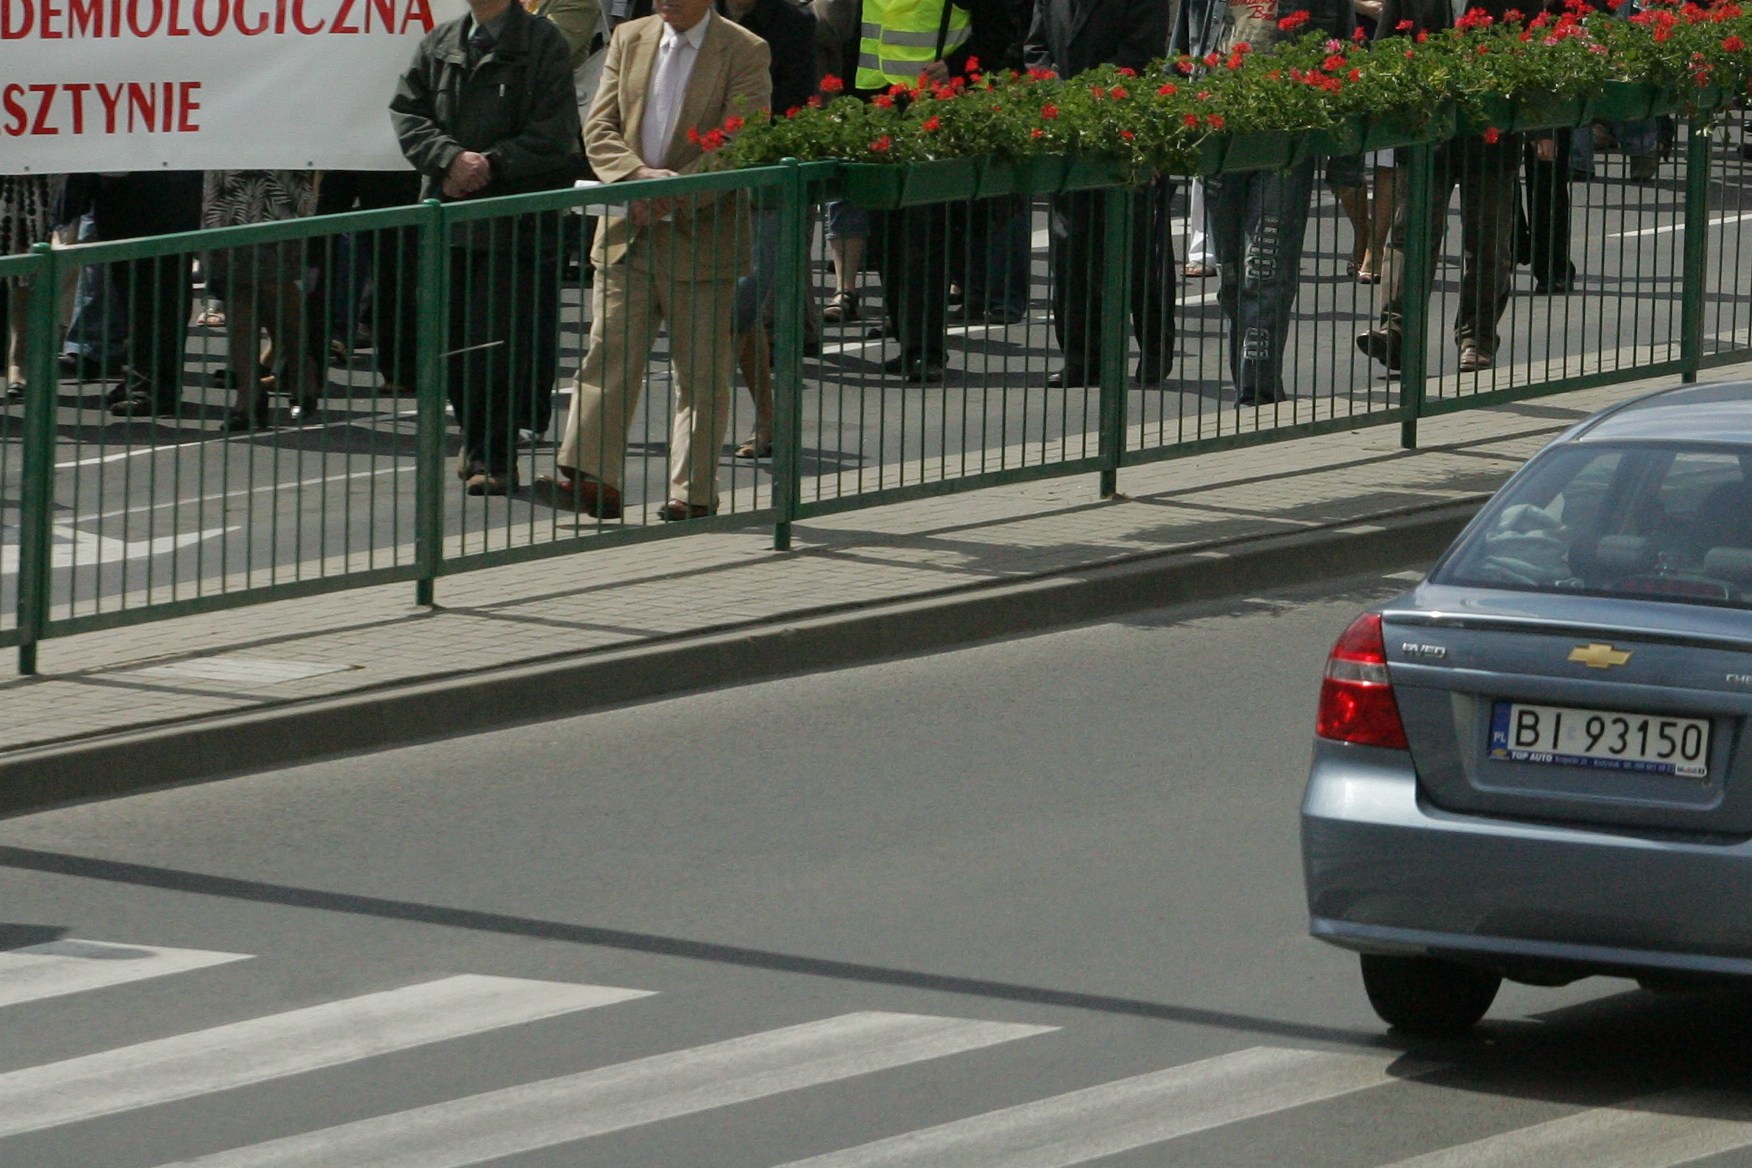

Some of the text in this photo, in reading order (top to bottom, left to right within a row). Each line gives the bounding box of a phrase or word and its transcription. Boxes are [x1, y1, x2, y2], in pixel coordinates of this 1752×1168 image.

[3, 81, 203, 137] SZTYNIE
[1511, 750, 1528, 761] TOP
[1529, 752, 1553, 764] AUTO
[1515, 709, 1562, 750] BI
[1584, 715, 1703, 761] 93150
